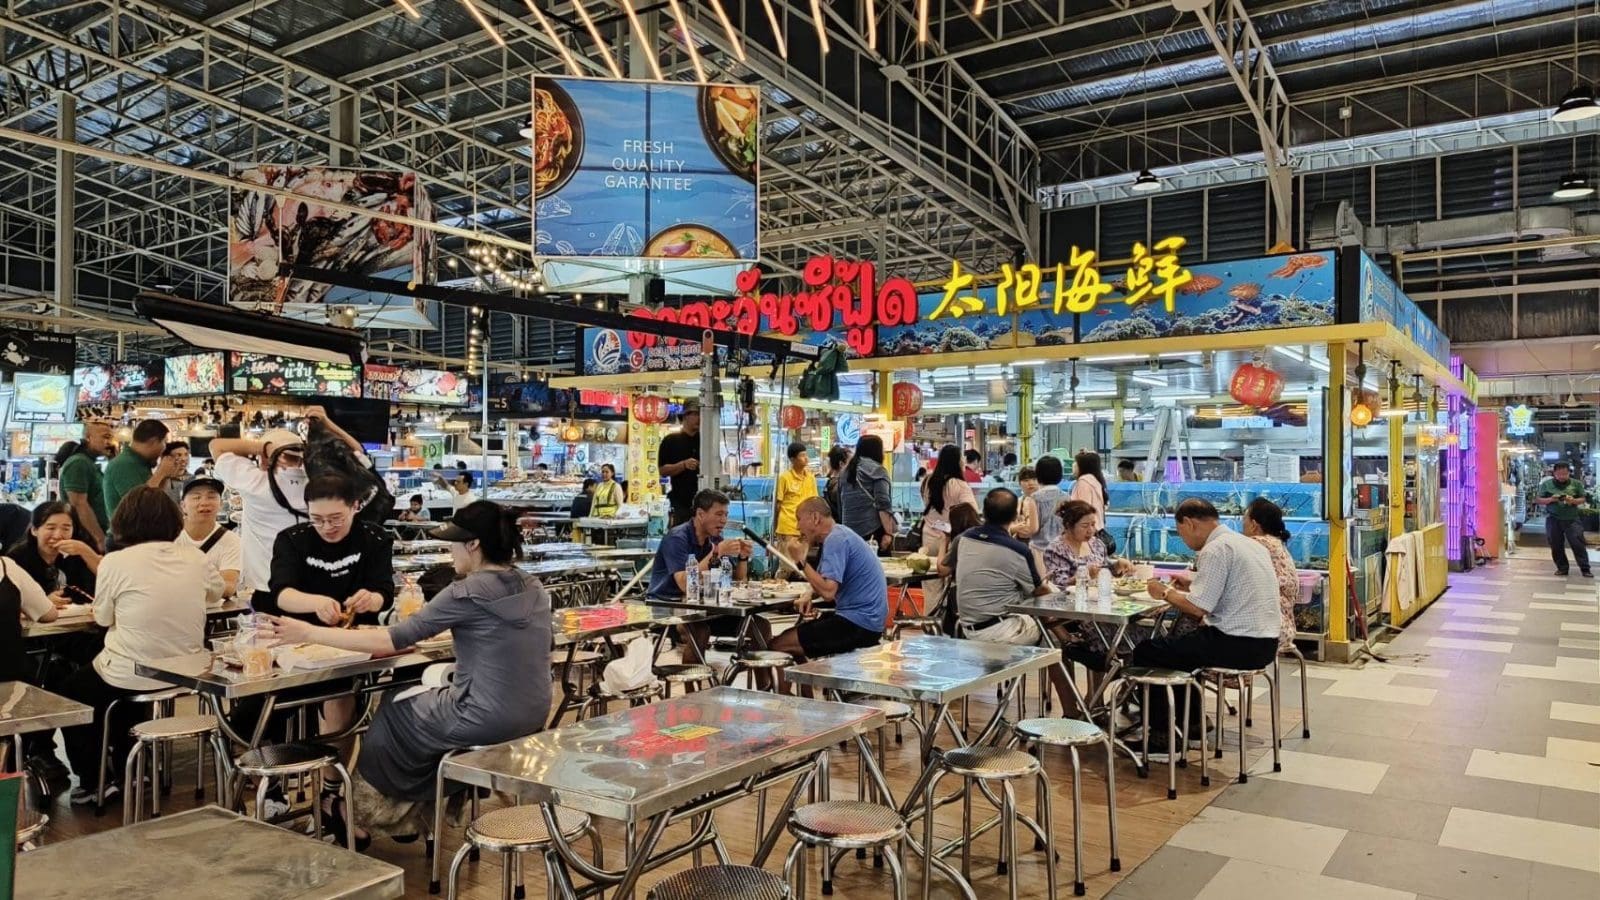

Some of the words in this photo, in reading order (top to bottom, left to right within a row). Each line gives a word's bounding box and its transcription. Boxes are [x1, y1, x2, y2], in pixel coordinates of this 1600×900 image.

[623, 139, 674, 155] FRESH
[612, 157, 686, 173] QUALITY
[604, 174, 692, 191] GARANTEE
[928, 236, 1194, 320] 太阳海鲜
